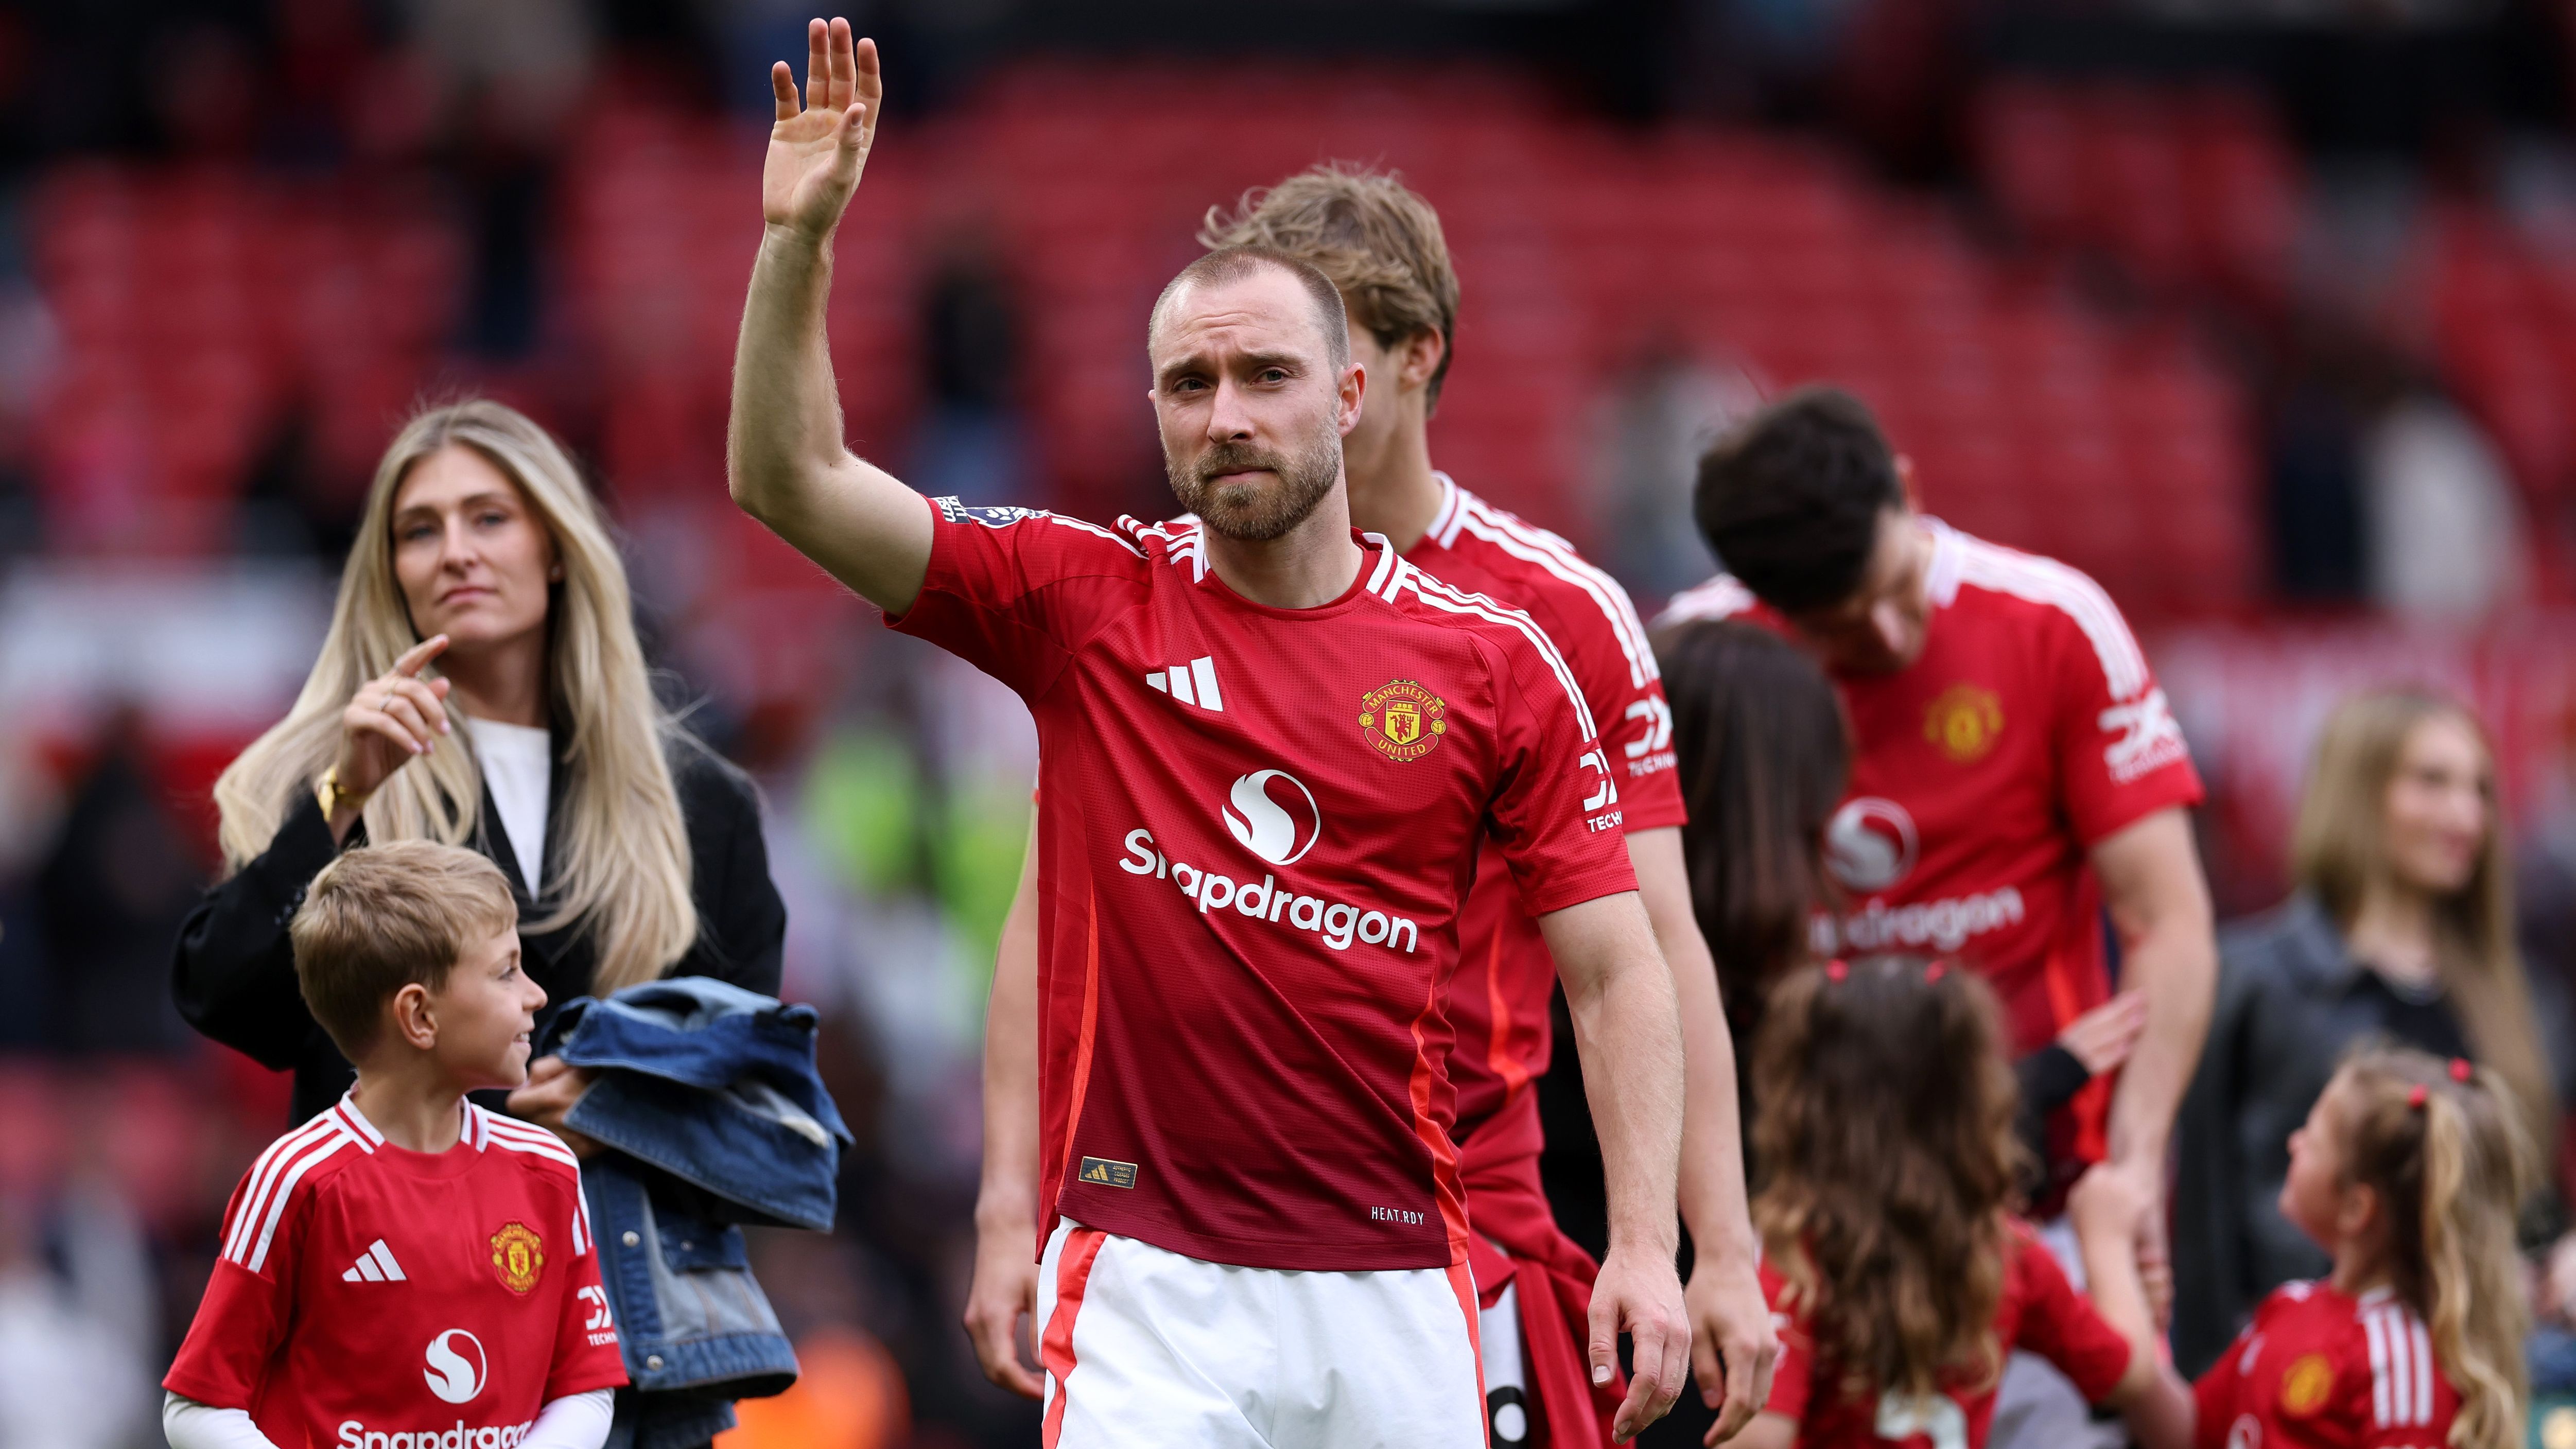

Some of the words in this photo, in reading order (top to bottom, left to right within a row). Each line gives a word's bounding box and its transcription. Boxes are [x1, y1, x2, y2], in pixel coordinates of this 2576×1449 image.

[1368, 686, 1438, 714] MANCHESTER
[1378, 739, 1426, 756] UNITED
[1371, 1206, 1424, 1226] HEAT.RDY
